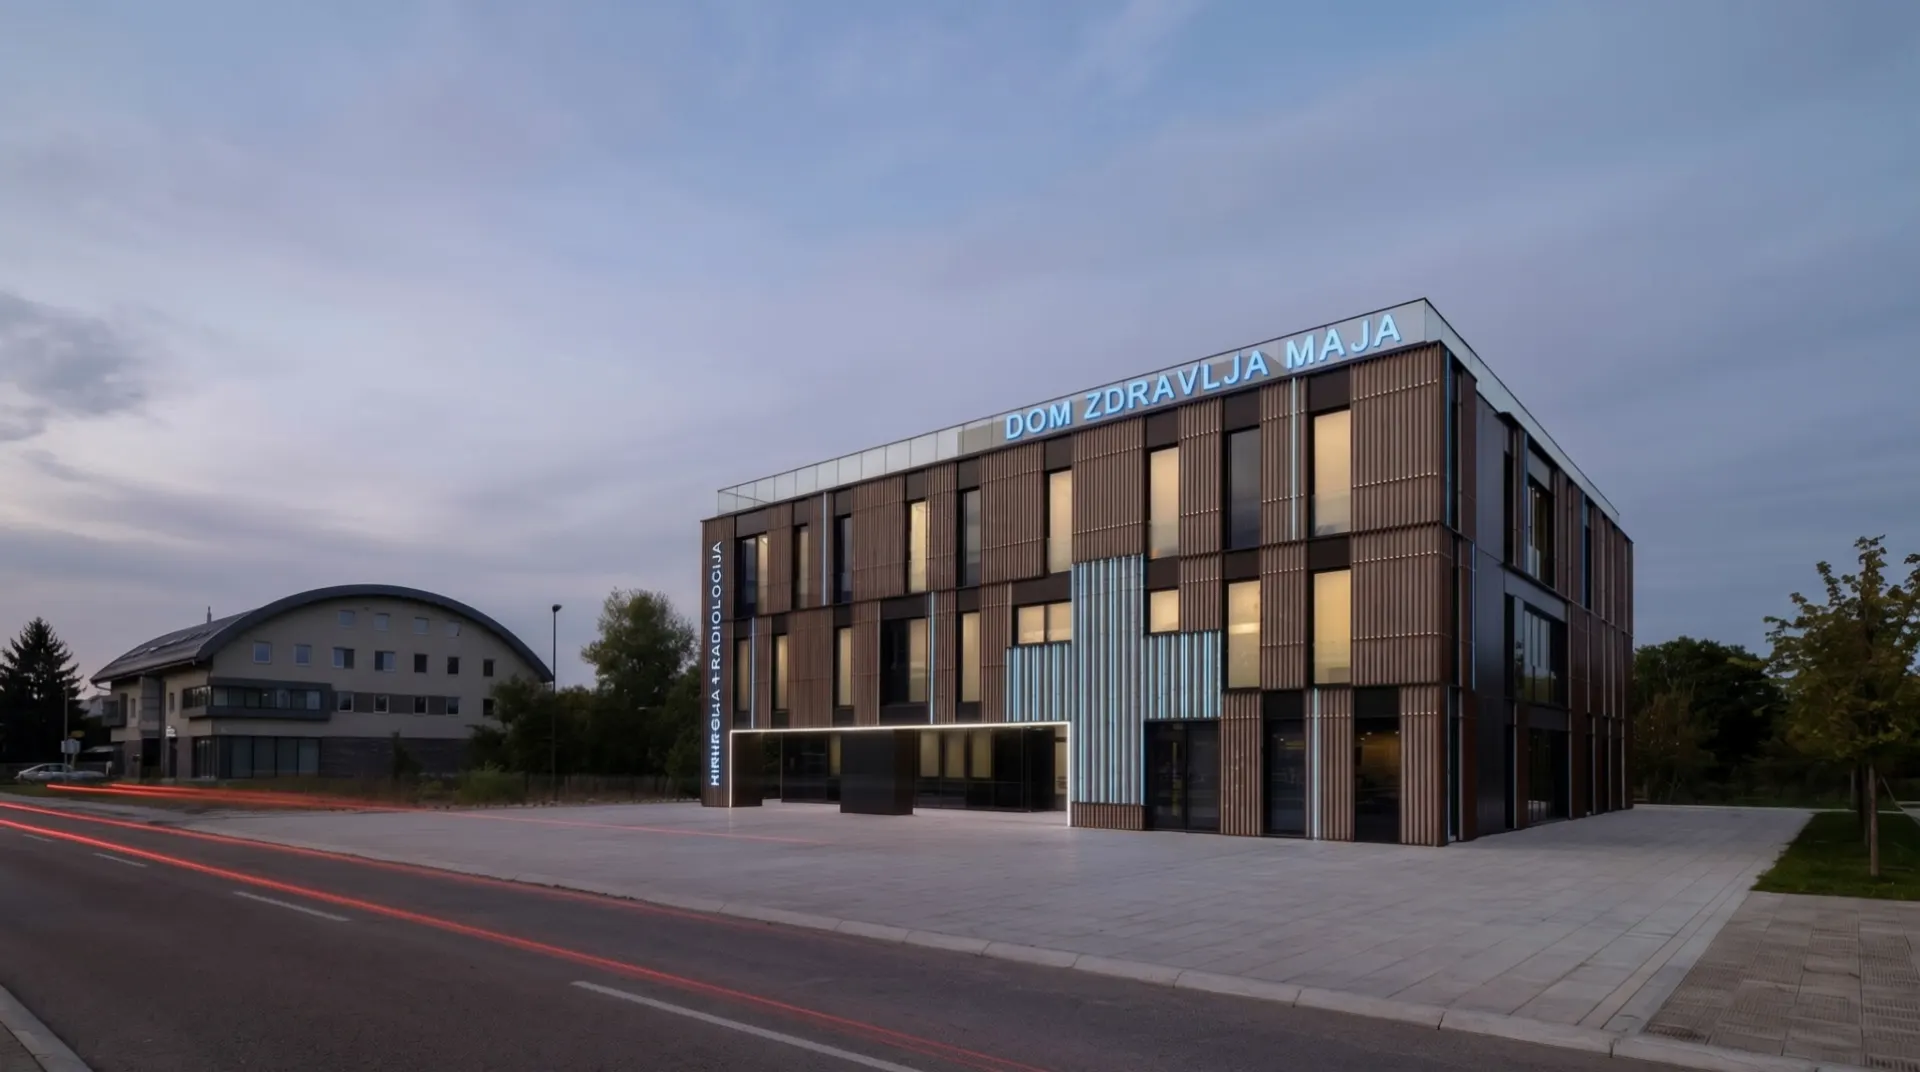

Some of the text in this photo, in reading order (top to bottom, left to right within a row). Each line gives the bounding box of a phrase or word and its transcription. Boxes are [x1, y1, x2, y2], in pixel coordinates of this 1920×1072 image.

[1005, 313, 1401, 440] DOM ZDRAVLJA MAJA
